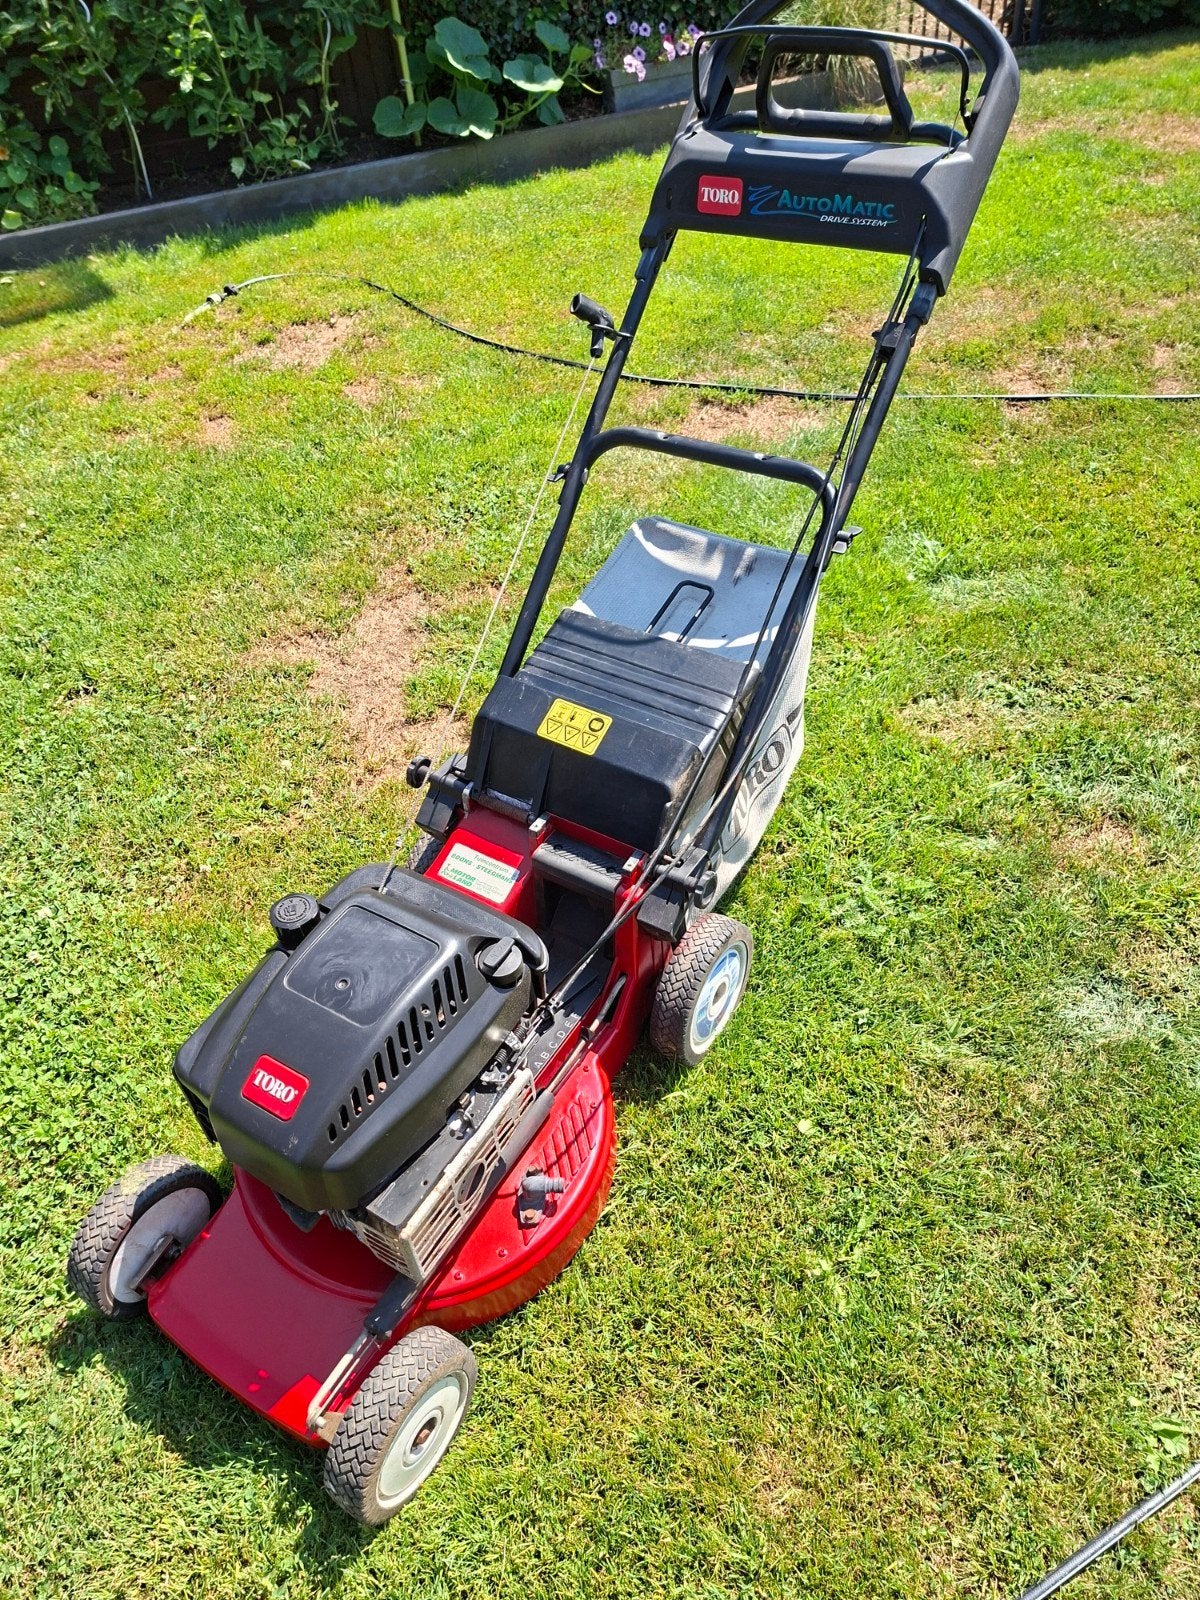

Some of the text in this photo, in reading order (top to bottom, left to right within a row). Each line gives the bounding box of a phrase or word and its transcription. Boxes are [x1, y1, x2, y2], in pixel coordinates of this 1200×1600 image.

[702, 187, 739, 204] TORO
[820, 215, 888, 227] DRIVE SYSTEM
[473, 854, 510, 874] Tuincentrum
[450, 867, 476, 882] MOTOR
[453, 874, 473, 887] LAND
[534, 1061, 543, 1069] A
[541, 1052, 550, 1060] B
[549, 1041, 558, 1049] C
[557, 1030, 566, 1038] D
[564, 1020, 573, 1028] E
[252, 1068, 299, 1103] TORO
